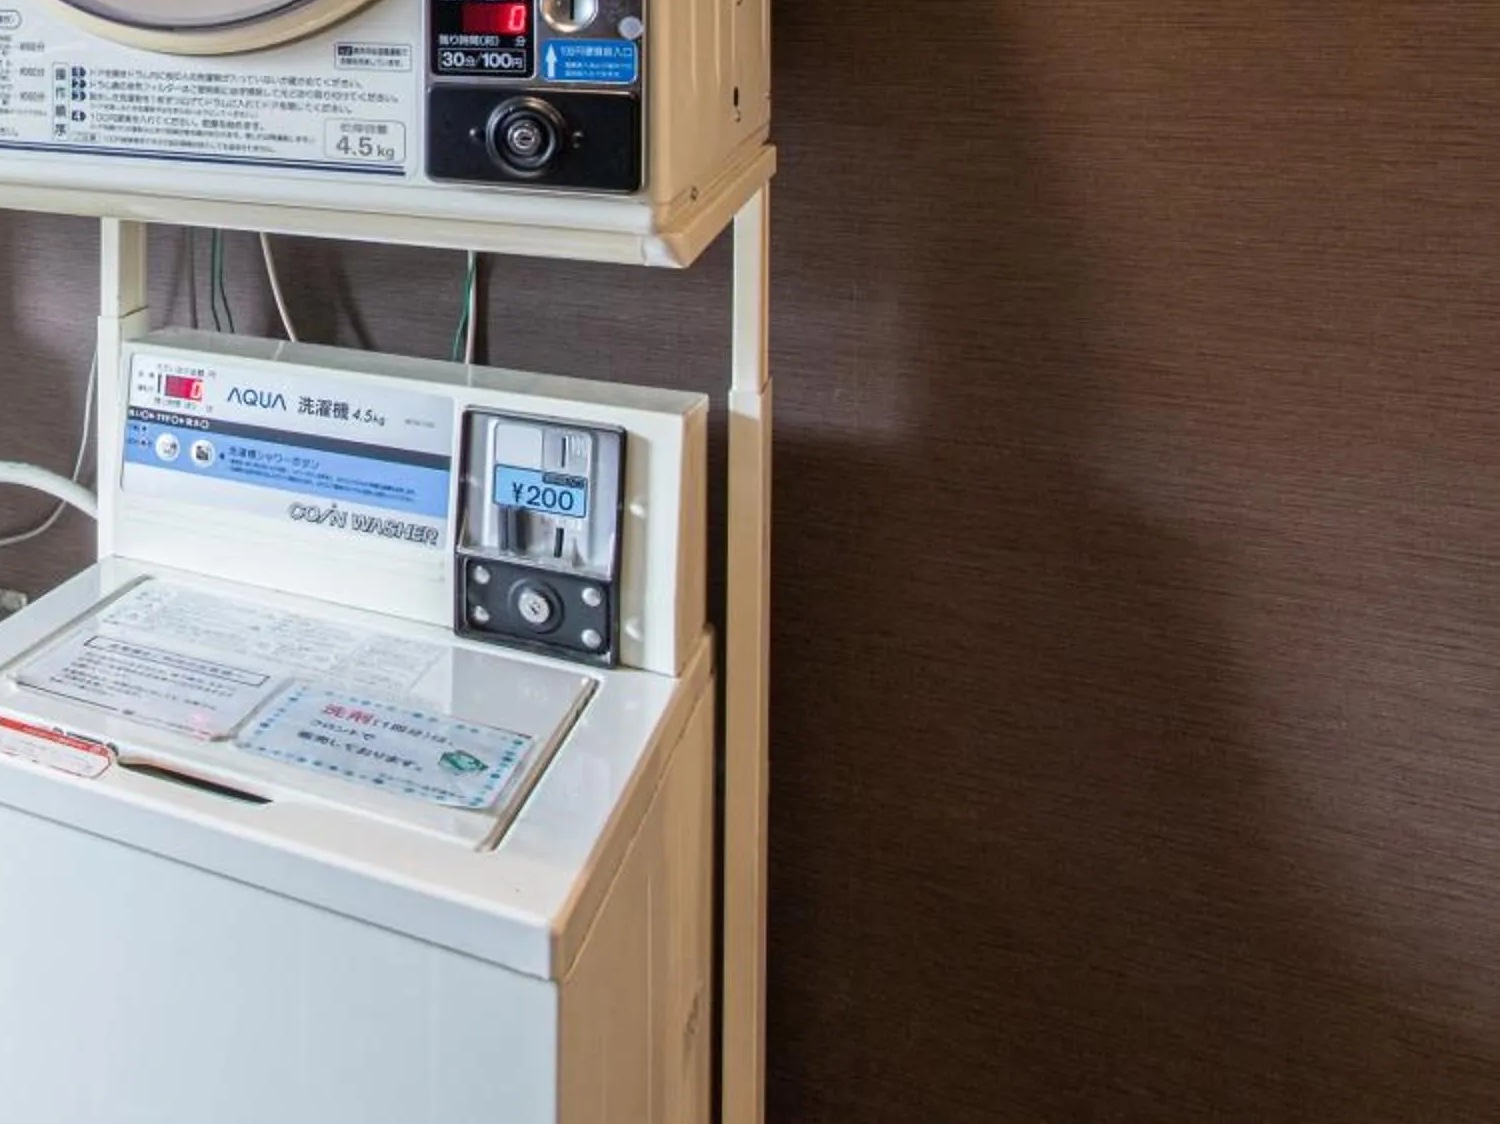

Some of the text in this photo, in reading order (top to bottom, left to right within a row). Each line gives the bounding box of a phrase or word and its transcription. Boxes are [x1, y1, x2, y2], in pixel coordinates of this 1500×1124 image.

[507, 4, 527, 32] 0
[226, 386, 288, 412] AQUA
[297, 395, 350, 419] 洗濯機
[352, 408, 386, 428] 4.5kg
[511, 480, 575, 512] ¥200
[351, 511, 440, 546] WASHER
